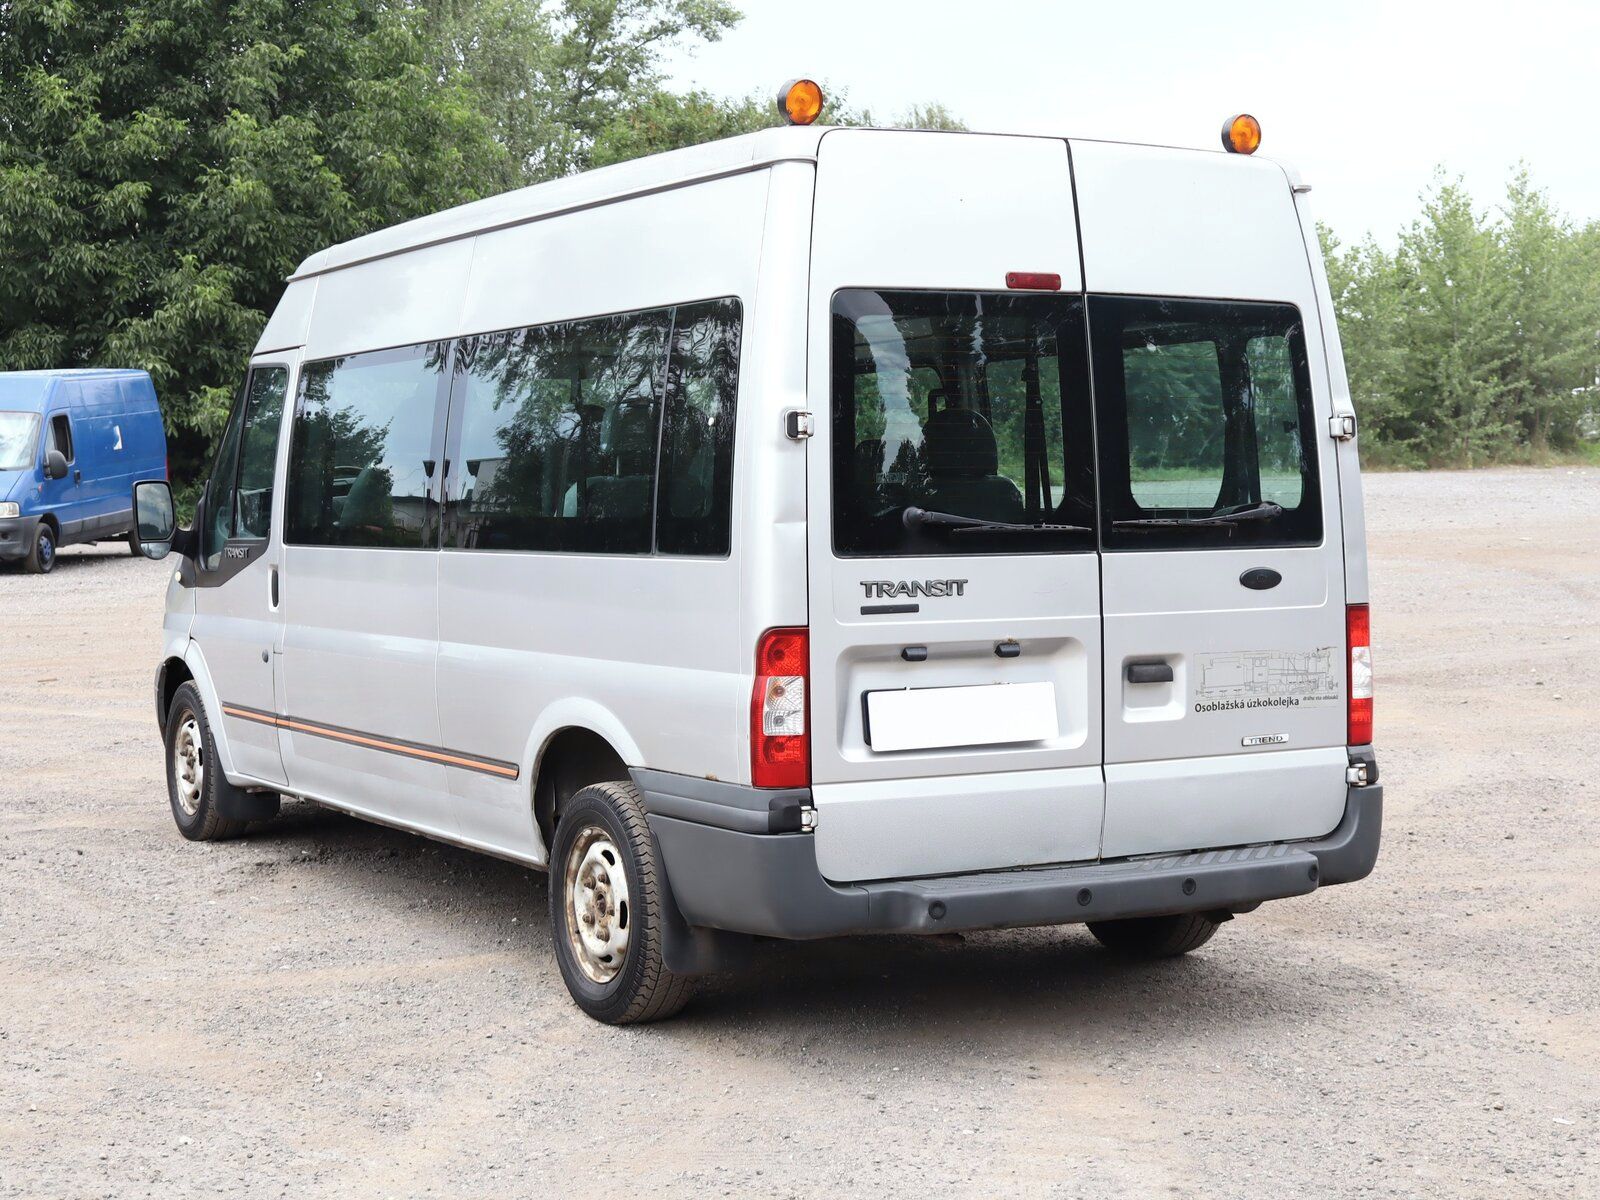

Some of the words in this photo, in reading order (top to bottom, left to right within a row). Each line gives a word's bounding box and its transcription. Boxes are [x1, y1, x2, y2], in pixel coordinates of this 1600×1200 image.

[860, 579, 968, 598] TRANSIT
[1194, 700, 1245, 712] Osoblažská
[1246, 696, 1300, 708] úzkokolejka
[1249, 735, 1284, 745] TREND
